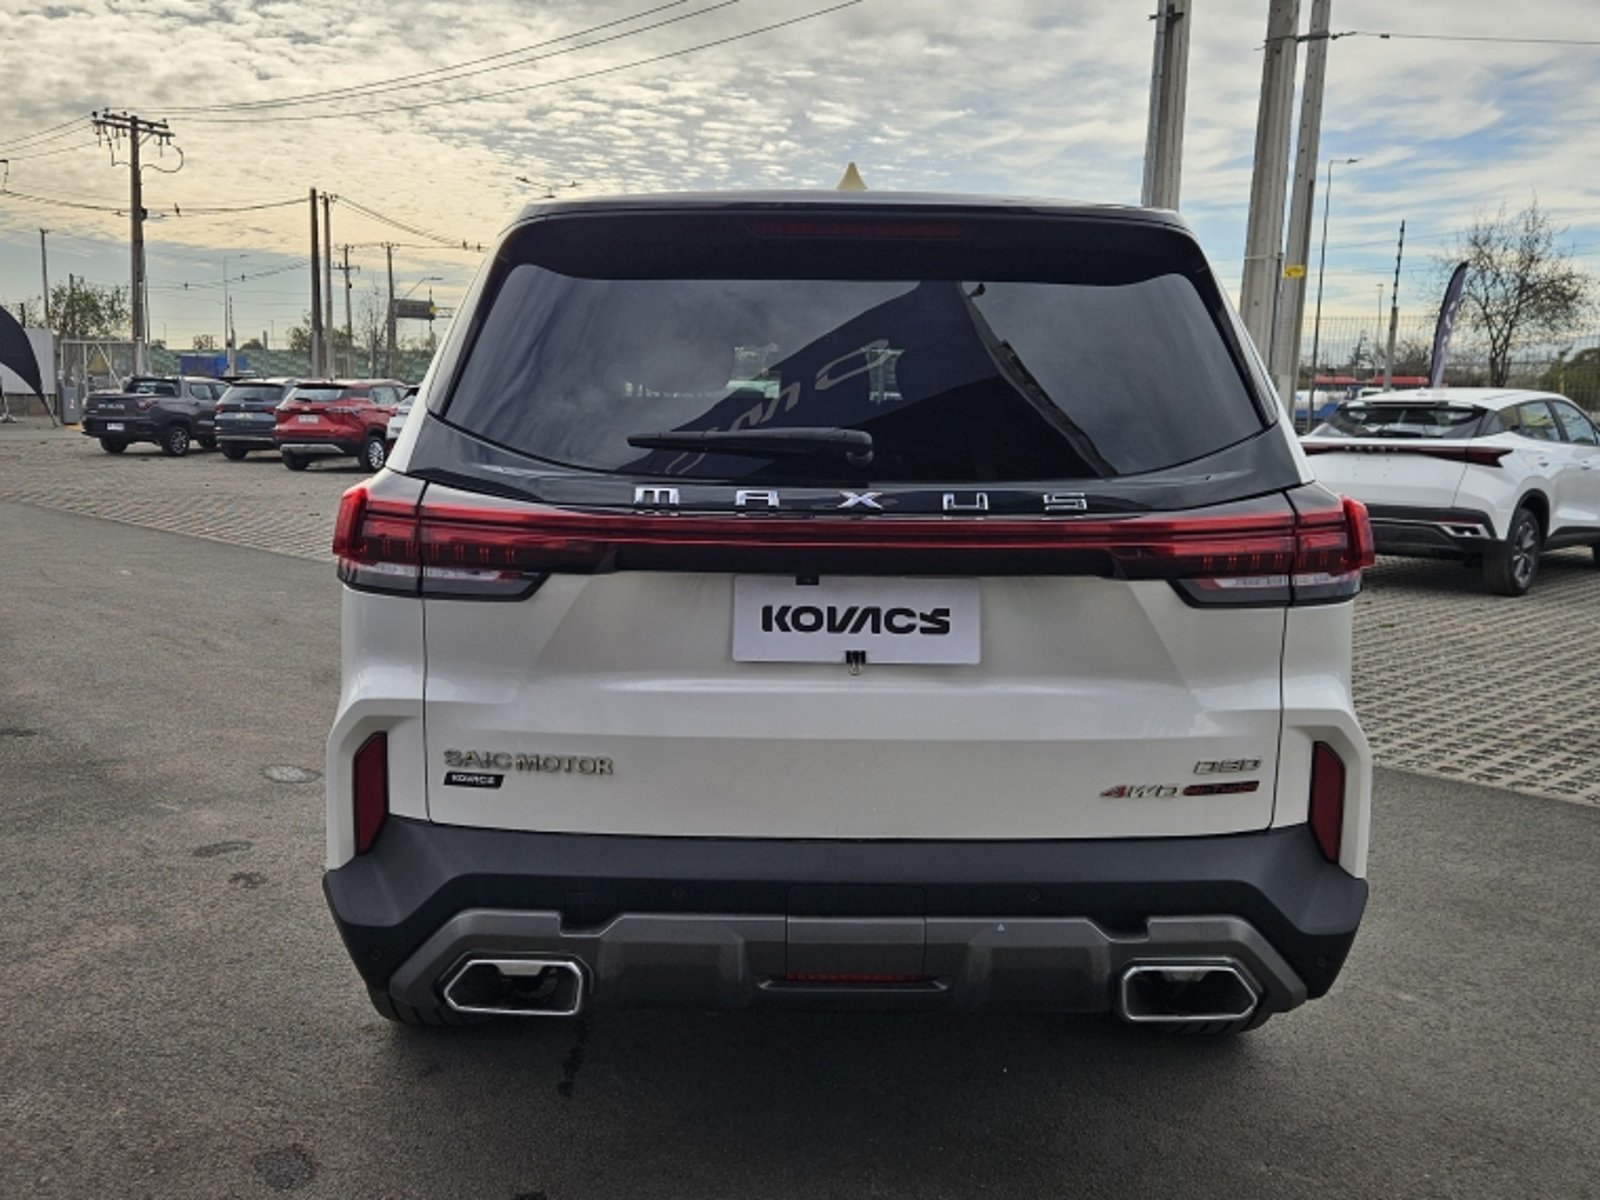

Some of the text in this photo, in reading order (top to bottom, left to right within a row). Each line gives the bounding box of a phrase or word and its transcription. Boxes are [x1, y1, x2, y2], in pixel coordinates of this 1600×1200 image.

[633, 486, 1088, 511] MAXUS
[762, 605, 951, 635] KOVACS
[443, 747, 614, 775] SAIC MOTOR
[451, 773, 496, 785] KOVACS
